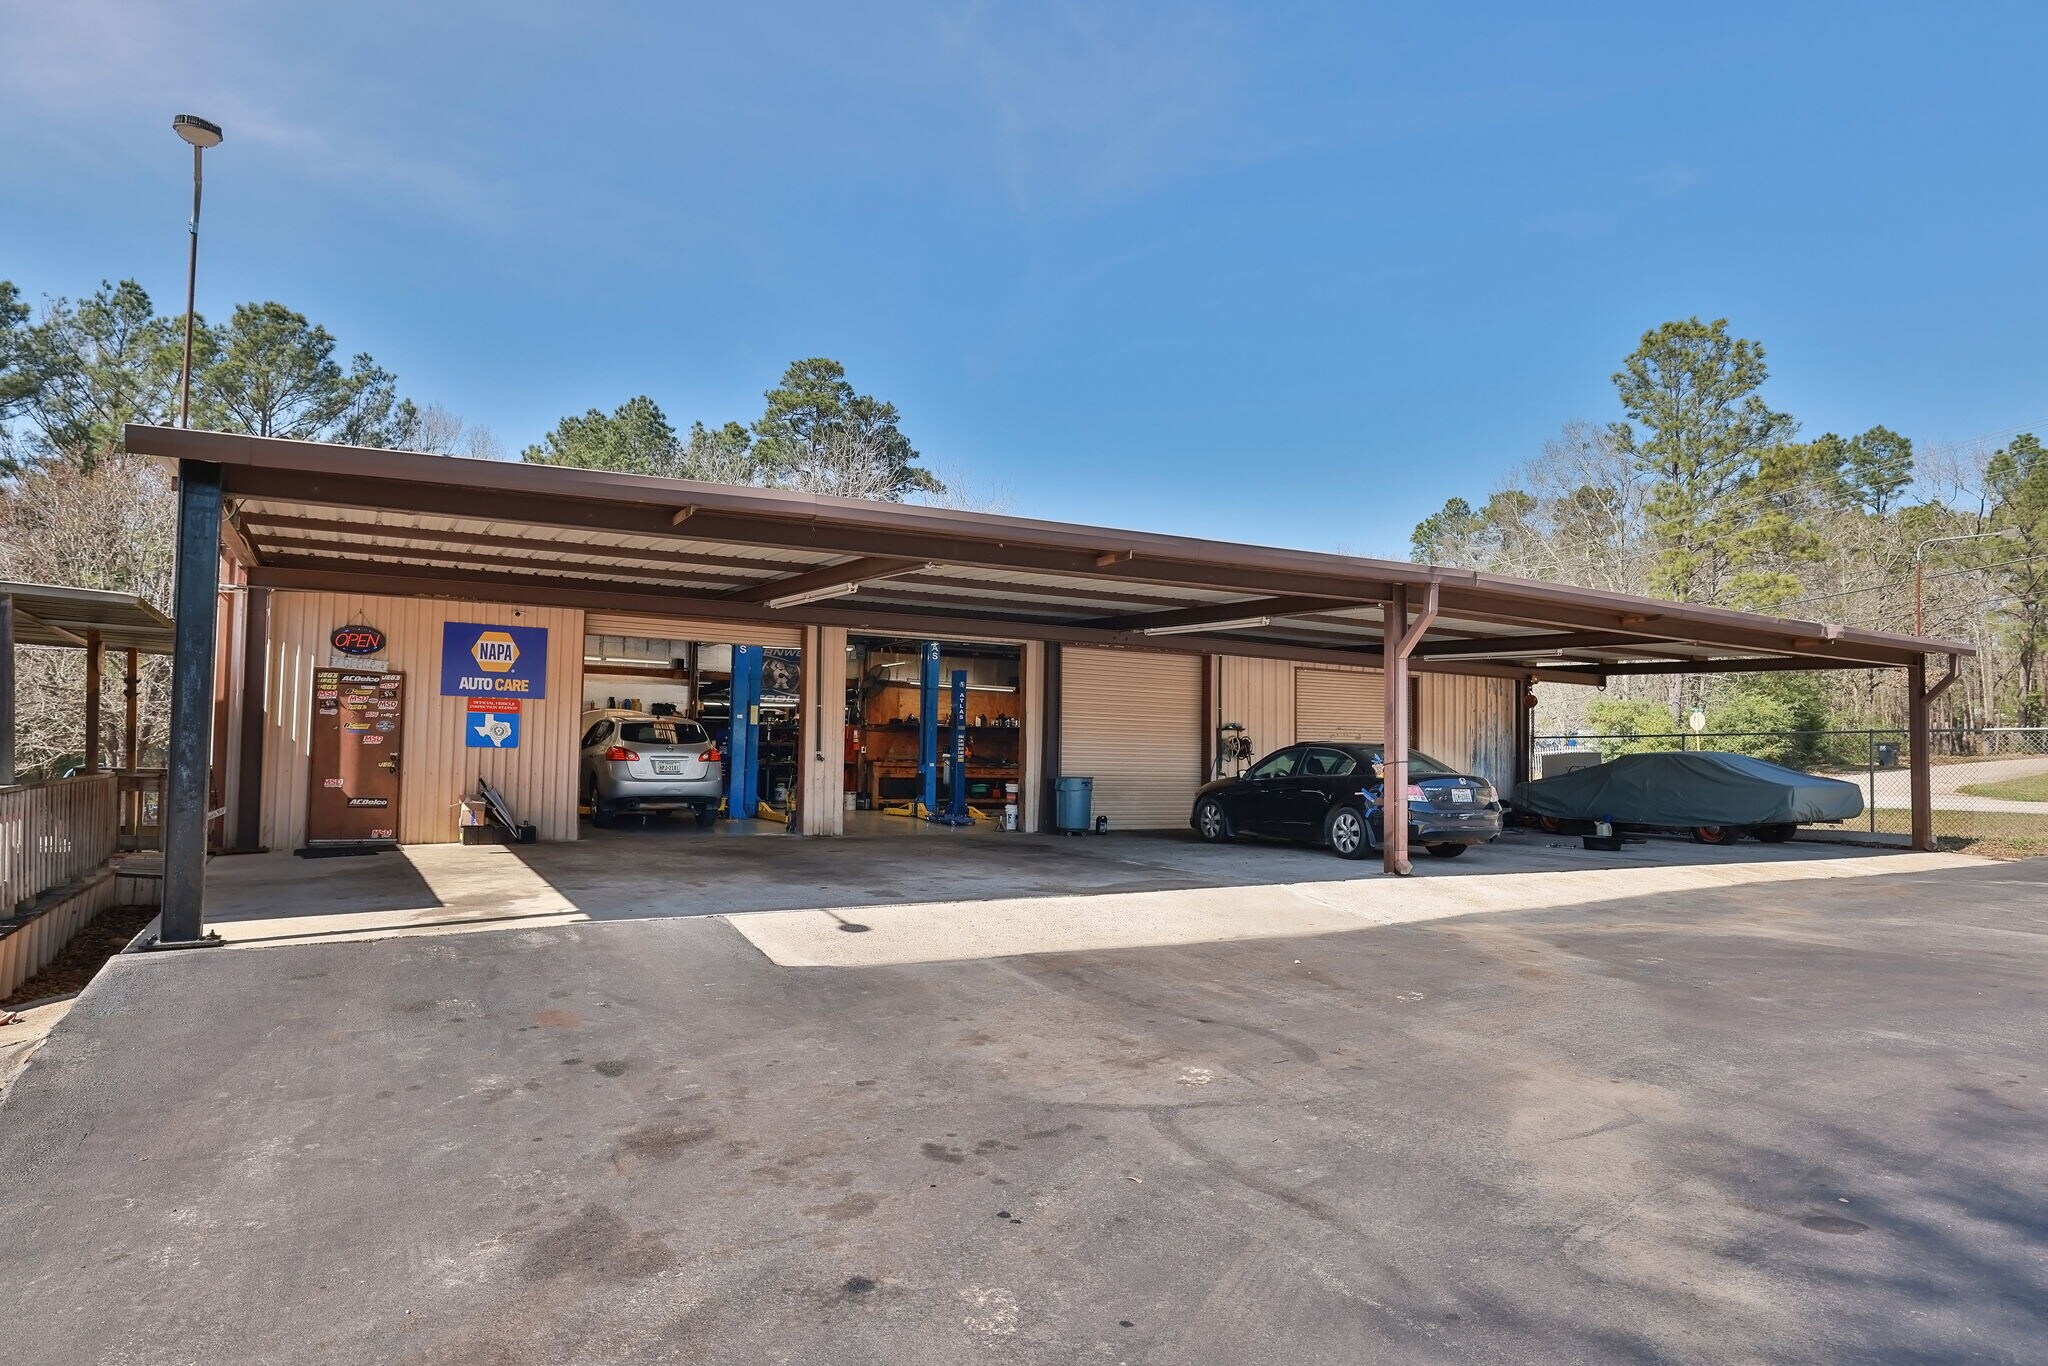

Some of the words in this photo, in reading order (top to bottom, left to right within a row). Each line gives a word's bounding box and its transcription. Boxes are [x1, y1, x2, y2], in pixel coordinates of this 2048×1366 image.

[335, 633, 380, 647] OPEN
[480, 643, 512, 660] NAPA
[459, 677, 493, 691] AUTO
[495, 678, 529, 692] CARE
